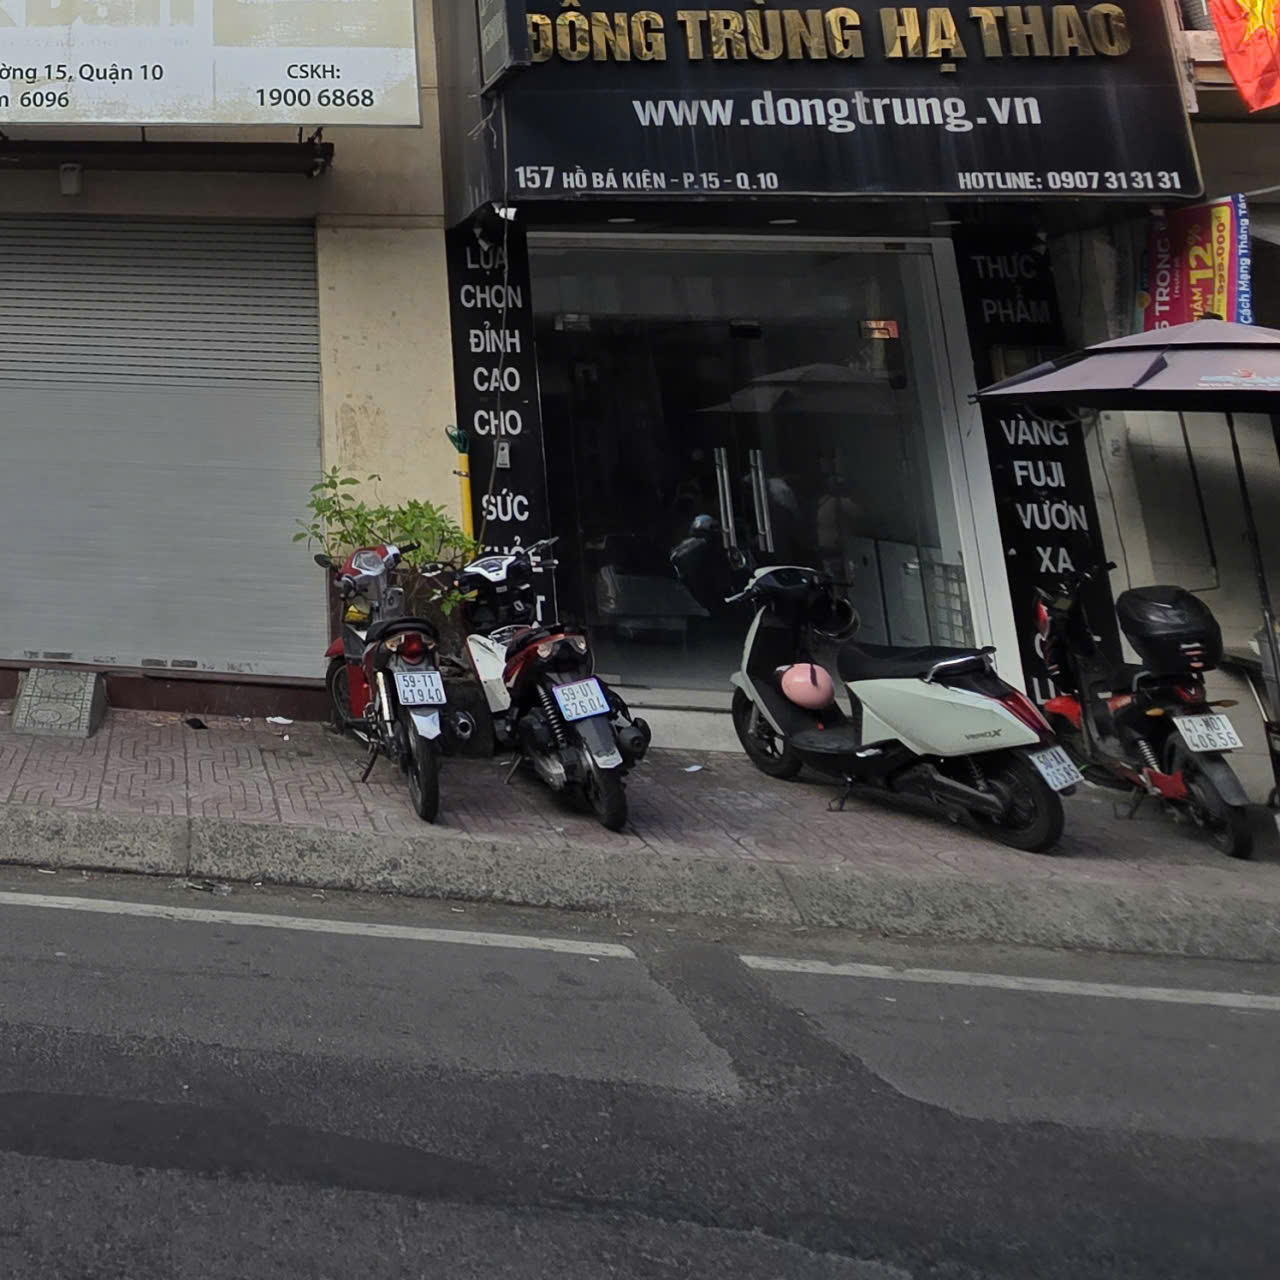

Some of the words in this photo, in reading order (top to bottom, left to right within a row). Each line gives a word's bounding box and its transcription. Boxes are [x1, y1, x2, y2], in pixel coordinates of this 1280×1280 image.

[879, 6, 967, 72] HẠ
[44, 63, 73, 83] 15,
[79, 62, 133, 84] Quận
[139, 64, 163, 80] 10
[287, 64, 341, 80] CSKH:
[19, 91, 69, 107] 6096
[257, 89, 311, 107] 1900
[317, 89, 374, 107] 6868
[632, 90, 1042, 133] www.dongtrung.vn
[515, 166, 555, 189] 157
[563, 164, 587, 188] HỒ
[592, 166, 618, 188] BÁ
[623, 168, 665, 191] KIỆN
[683, 173, 719, 189] P.15
[736, 172, 779, 189] Q.10
[958, 172, 1042, 190] HOTLINE:
[1047, 171, 1099, 189] 0907
[460, 285, 522, 315] CHỌN
[469, 321, 520, 353] ĐỈNH
[473, 367, 520, 392] CAO
[474, 410, 522, 436] CHO
[1000, 415, 1069, 446] VÀNG
[1014, 460, 1065, 488] FUJI
[482, 489, 529, 522] SỨC
[1015, 501, 1089, 532] VƯƠN
[1036, 546, 1075, 574] XA
[402, 675, 435, 688] 59-T1
[561, 684, 595, 702] 59-U1
[402, 689, 442, 704] 419.40
[563, 697, 605, 718] 526.04
[1190, 732, 1238, 749] 406.56
